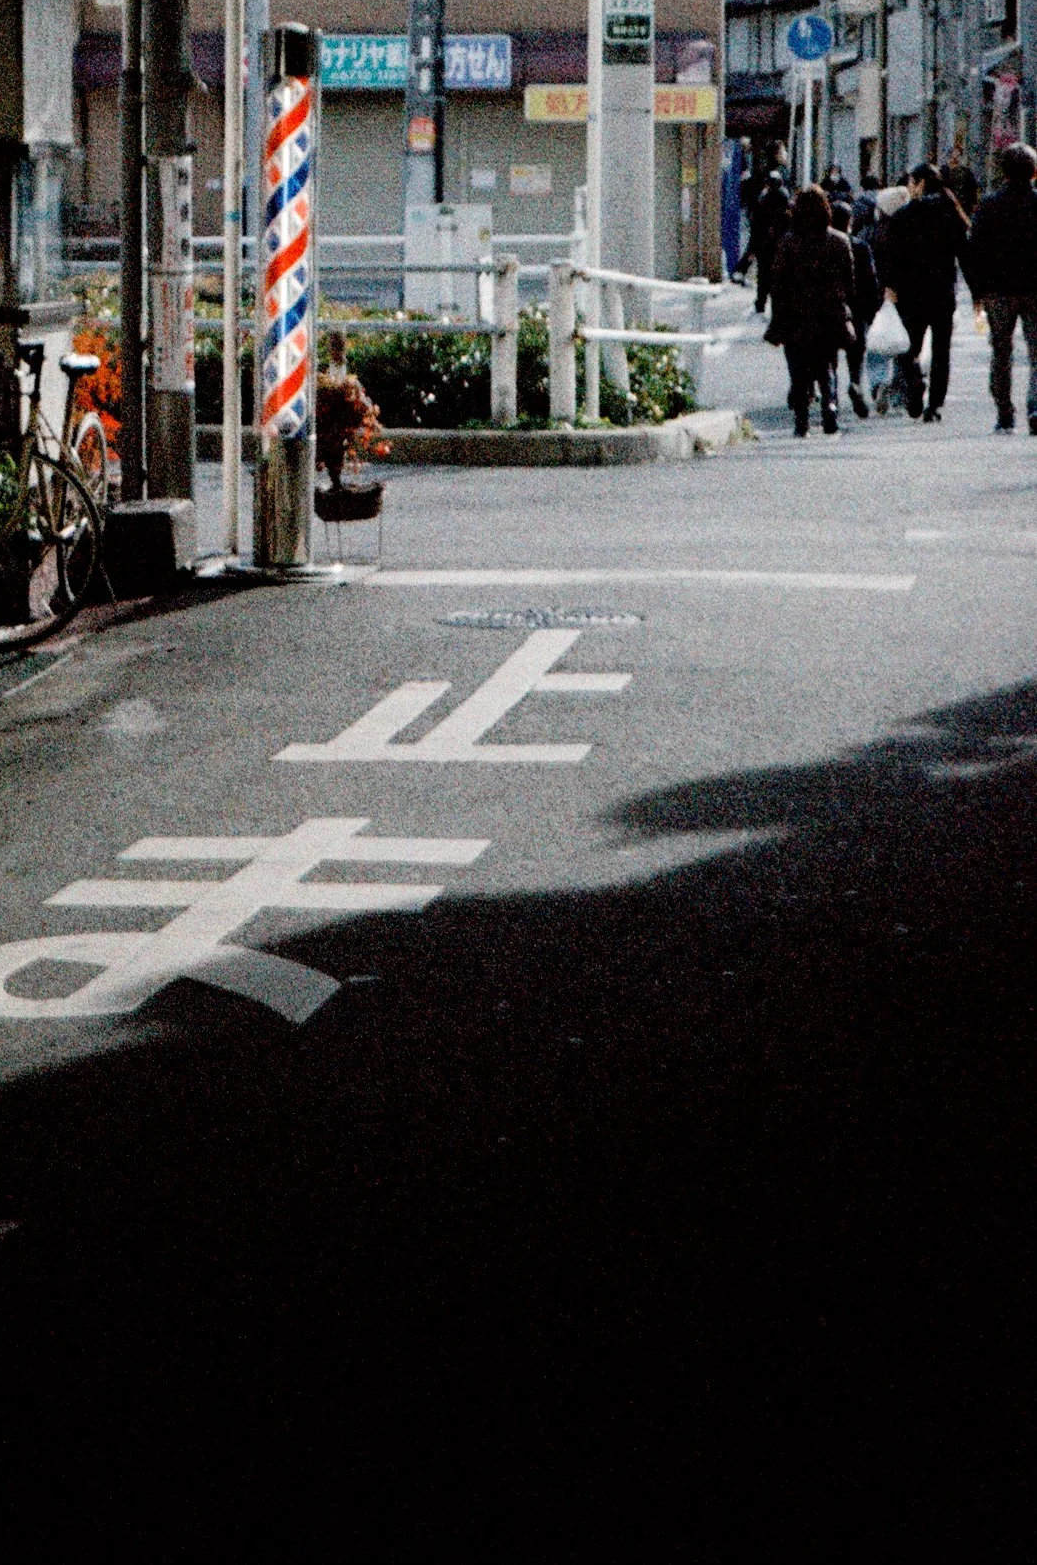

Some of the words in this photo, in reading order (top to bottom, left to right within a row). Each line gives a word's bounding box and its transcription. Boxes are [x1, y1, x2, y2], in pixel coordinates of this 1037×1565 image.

[321, 40, 409, 69] カナリヤ薬
[446, 41, 507, 80] 方せん
